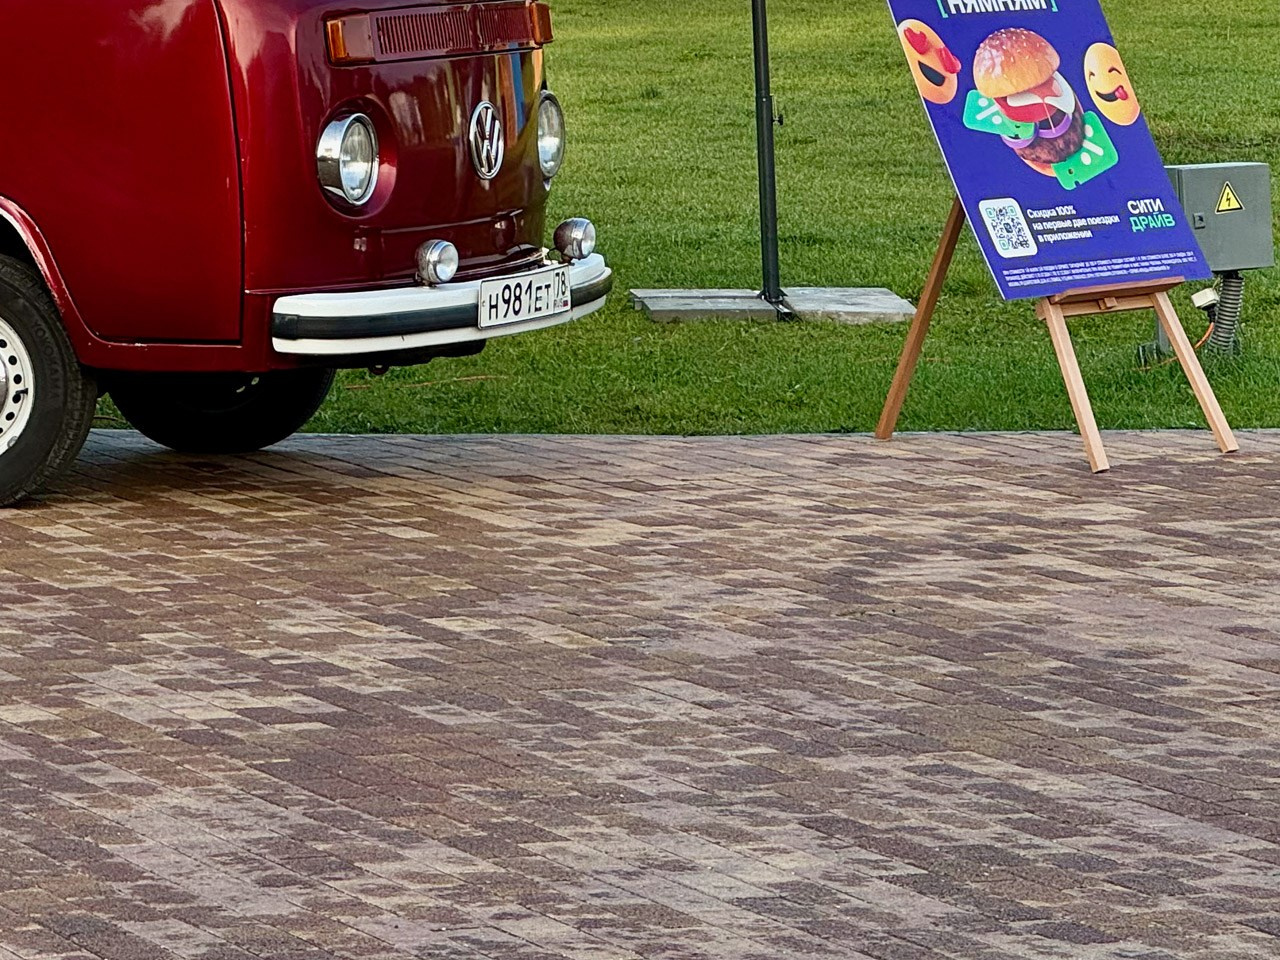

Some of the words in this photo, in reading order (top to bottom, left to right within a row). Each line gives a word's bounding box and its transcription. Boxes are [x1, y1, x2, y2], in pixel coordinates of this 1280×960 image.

[1026, 207, 1057, 219] Скидка
[1127, 197, 1165, 214] СИТИ
[1032, 221, 1044, 231] на
[1043, 219, 1073, 231] первые
[1072, 217, 1088, 228] две
[1087, 214, 1121, 226] поездки
[1129, 211, 1176, 233] ДРАЙВ
[1044, 230, 1093, 244] приложении
[554, 270, 569, 299] 78
